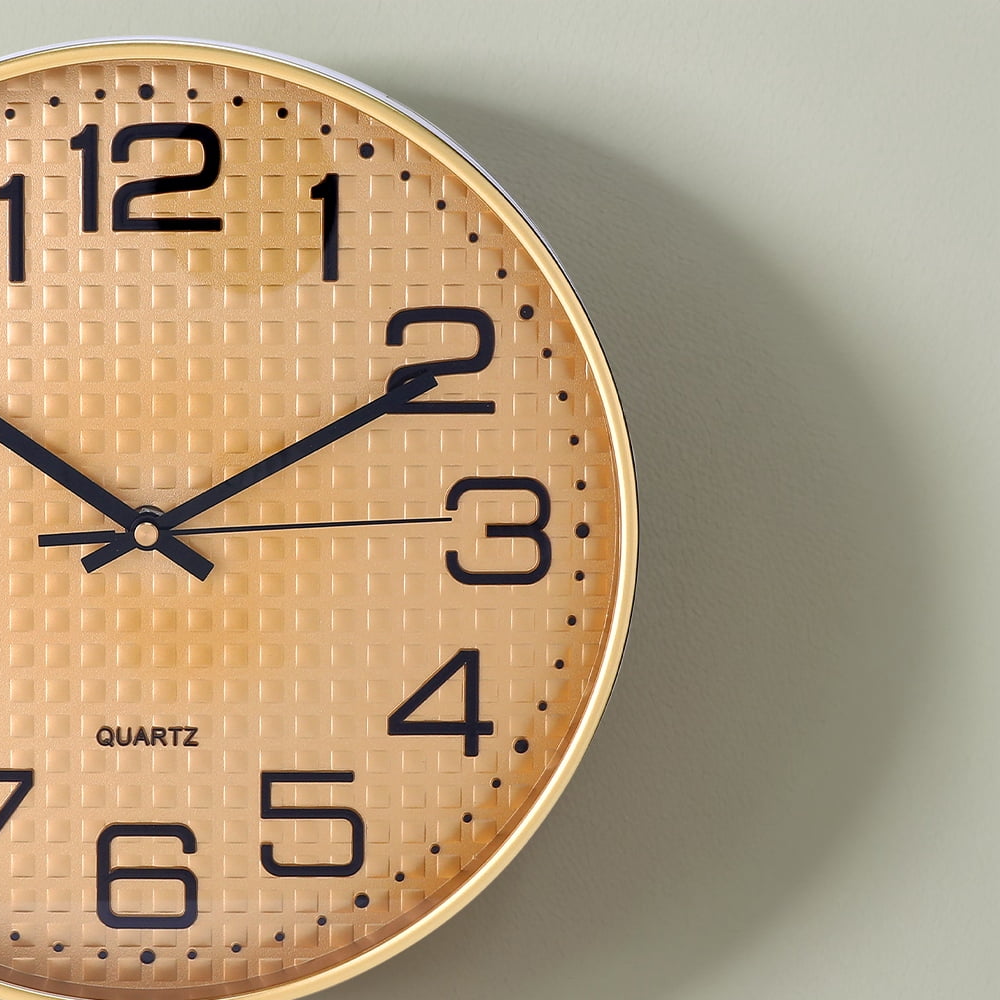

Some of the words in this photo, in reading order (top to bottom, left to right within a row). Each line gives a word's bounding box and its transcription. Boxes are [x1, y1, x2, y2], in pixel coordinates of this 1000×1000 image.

[70, 122, 223, 233] 12
[310, 172, 340, 282] 1
[385, 305, 496, 414] 2
[445, 475, 552, 587] 3
[96, 726, 199, 747] QUARTZ
[387, 648, 494, 758] 4
[96, 823, 199, 930] 6
[259, 770, 365, 878] 5
